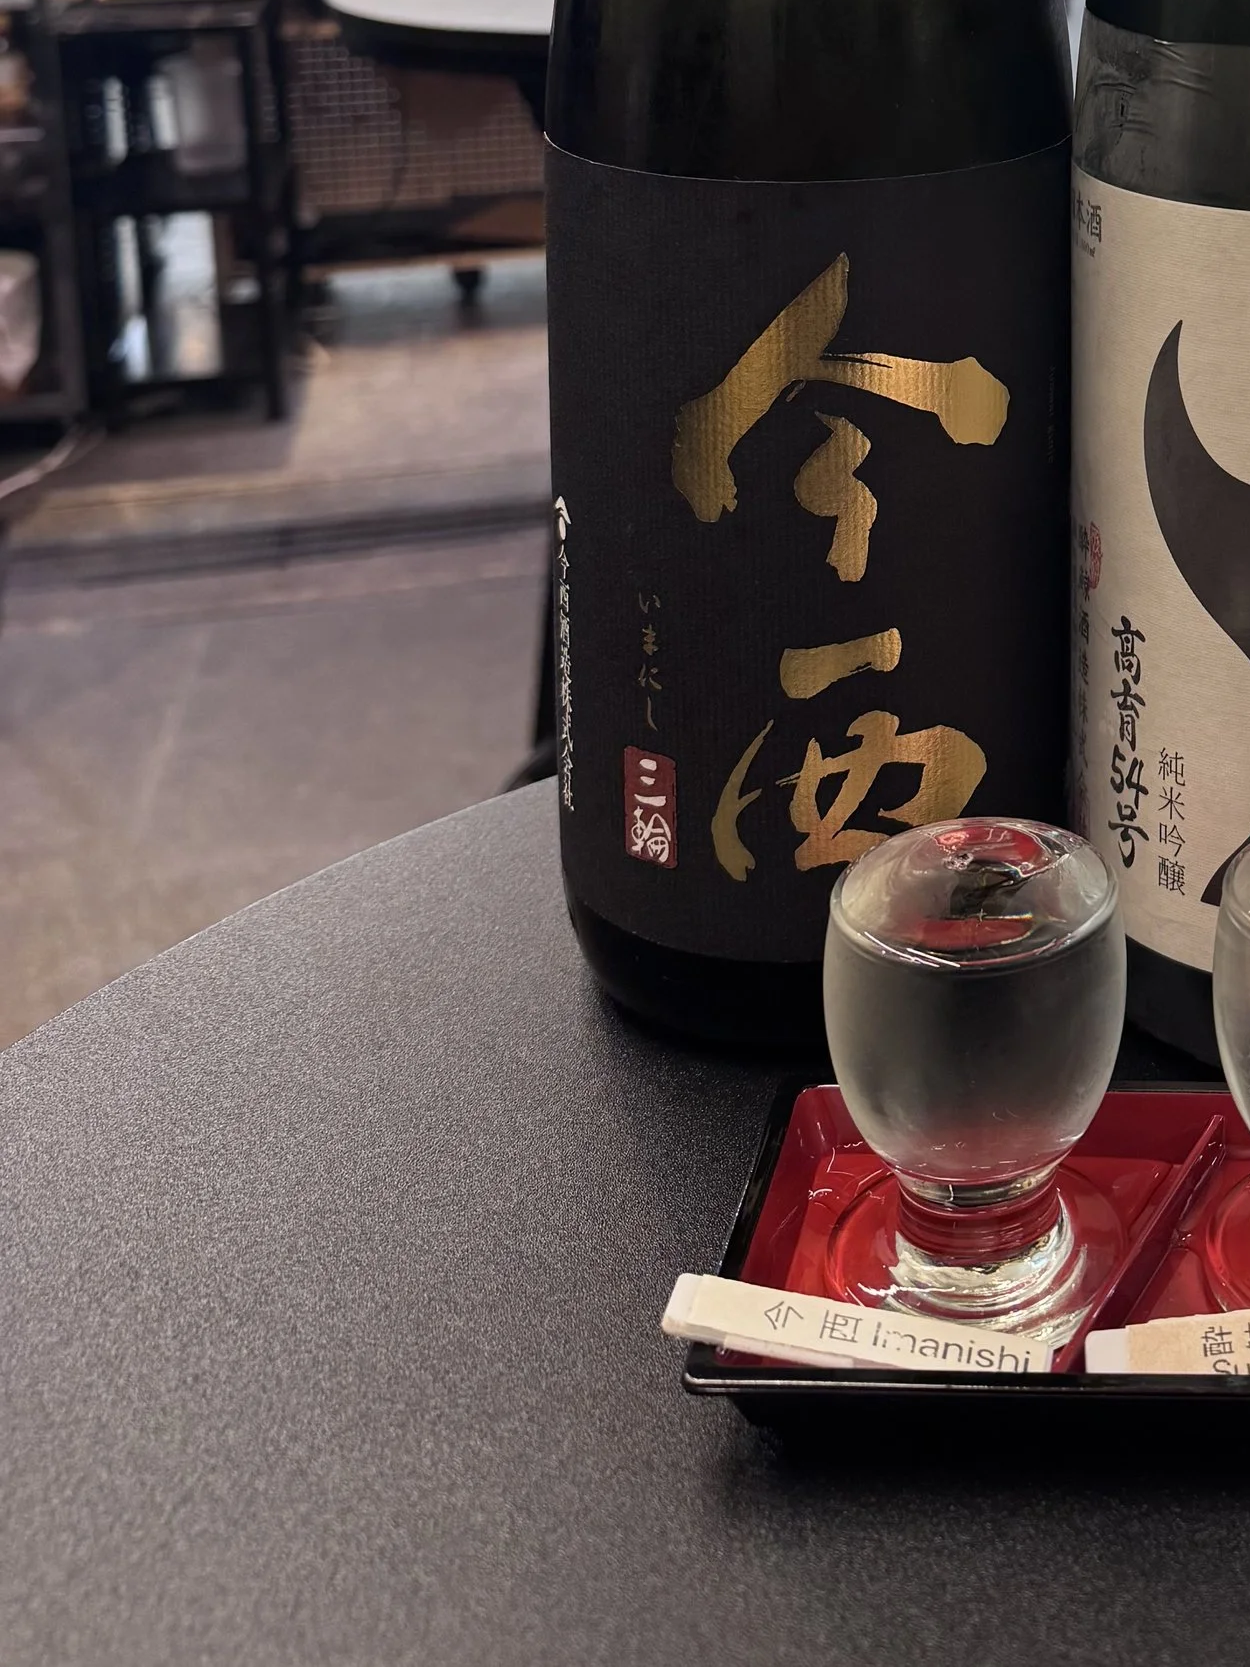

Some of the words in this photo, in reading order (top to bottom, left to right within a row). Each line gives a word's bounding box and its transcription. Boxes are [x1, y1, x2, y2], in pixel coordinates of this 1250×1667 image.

[637, 590, 663, 733] いまにし
[1108, 615, 1150, 869] 高育54号
[1158, 746, 1187, 896] 純米吟醸
[763, 1300, 864, 1344] 今西
[871, 1320, 1032, 1373] Imanishi
